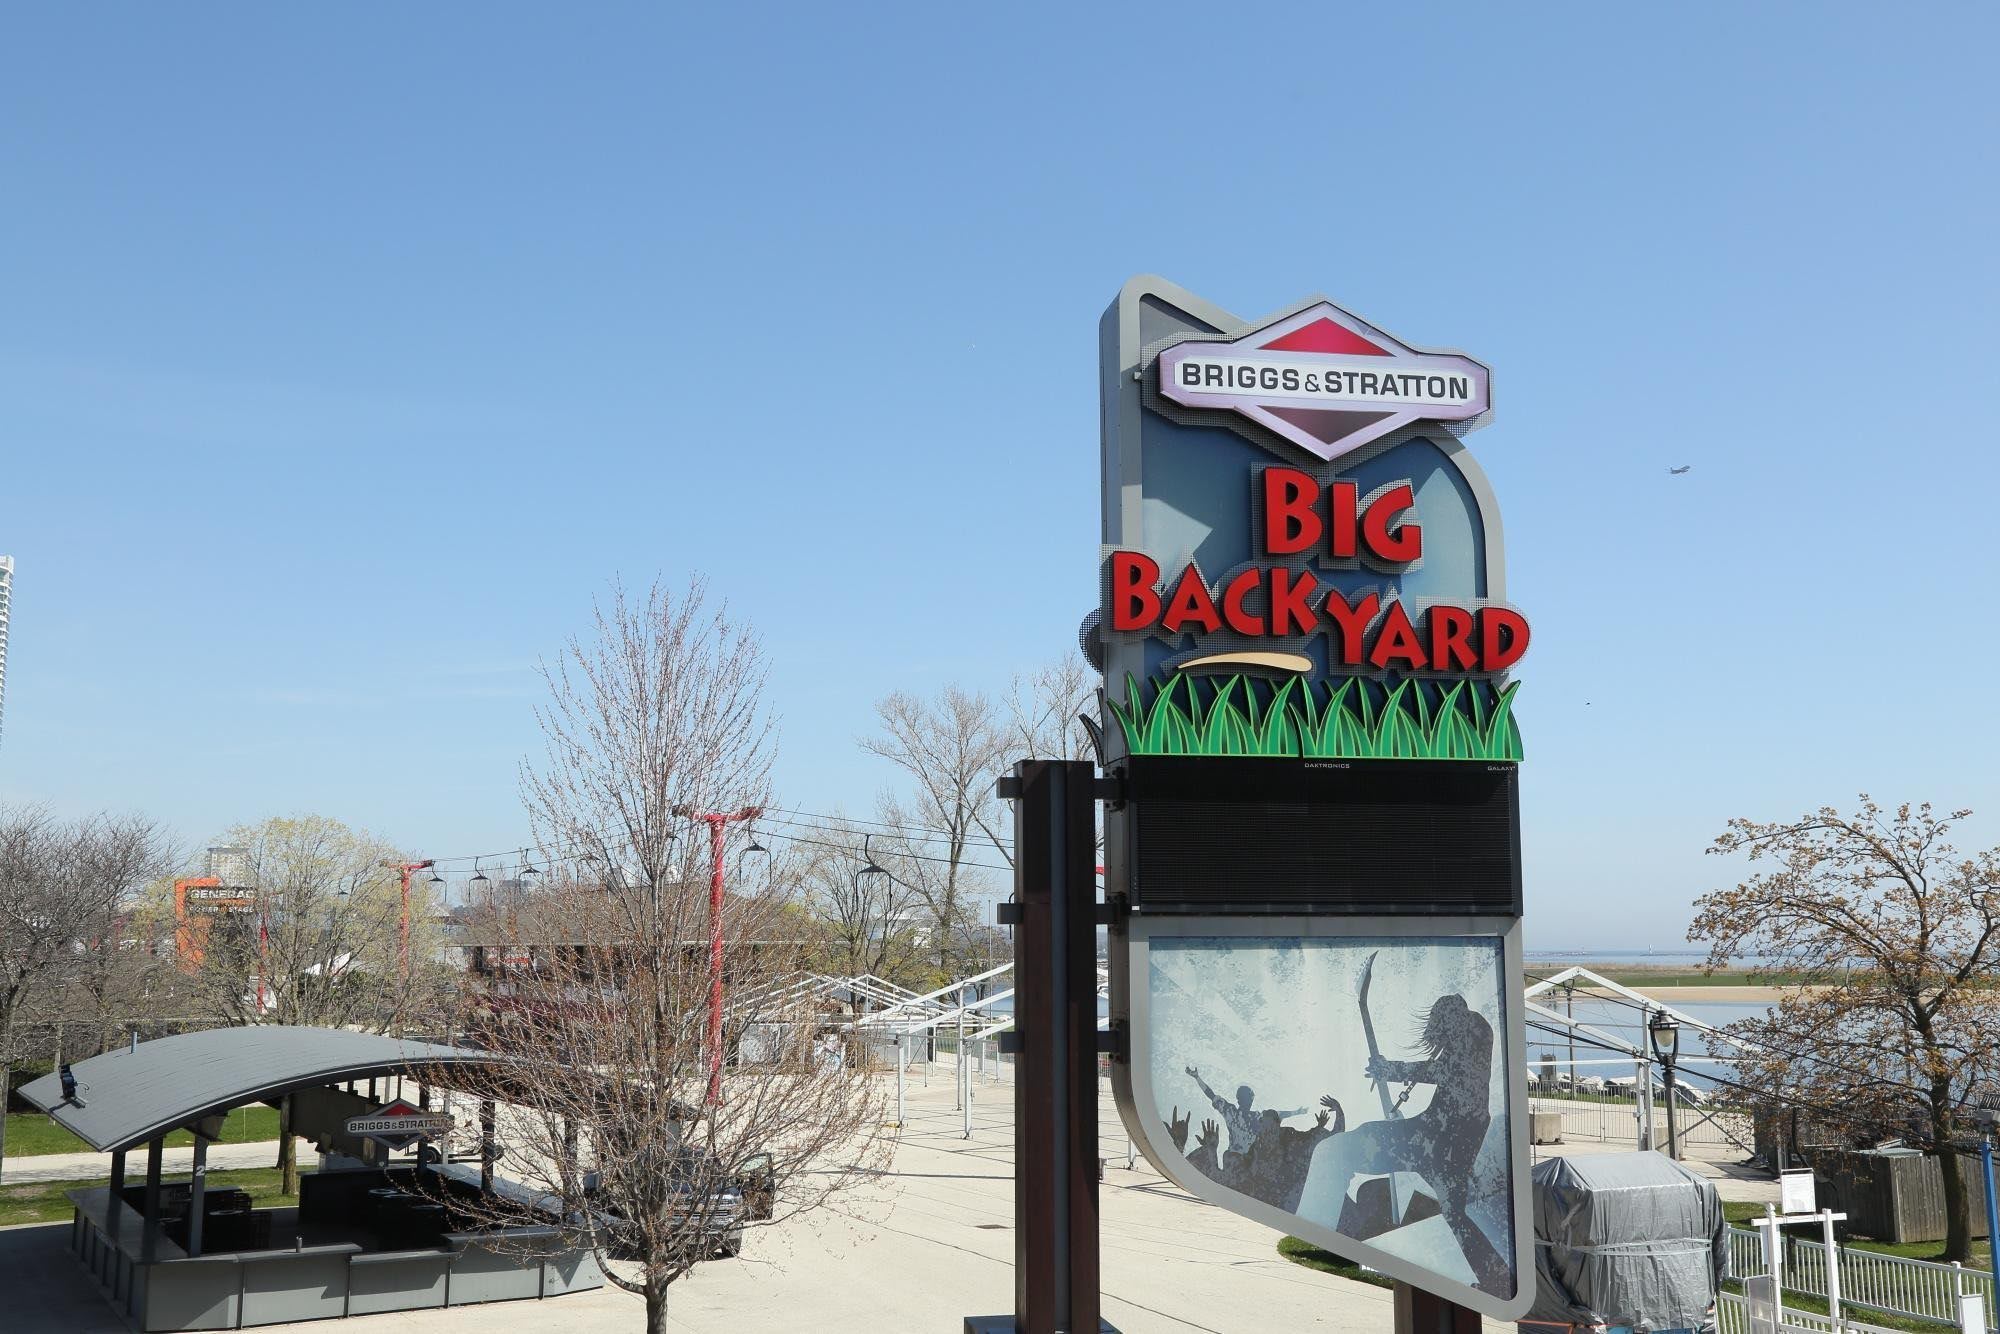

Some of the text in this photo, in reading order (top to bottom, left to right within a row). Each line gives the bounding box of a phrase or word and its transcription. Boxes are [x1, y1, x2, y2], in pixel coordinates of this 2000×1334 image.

[1264, 467, 1422, 563] BIG
[1112, 551, 1530, 672] BACKYARD
[195, 1165, 206, 1177] 2
